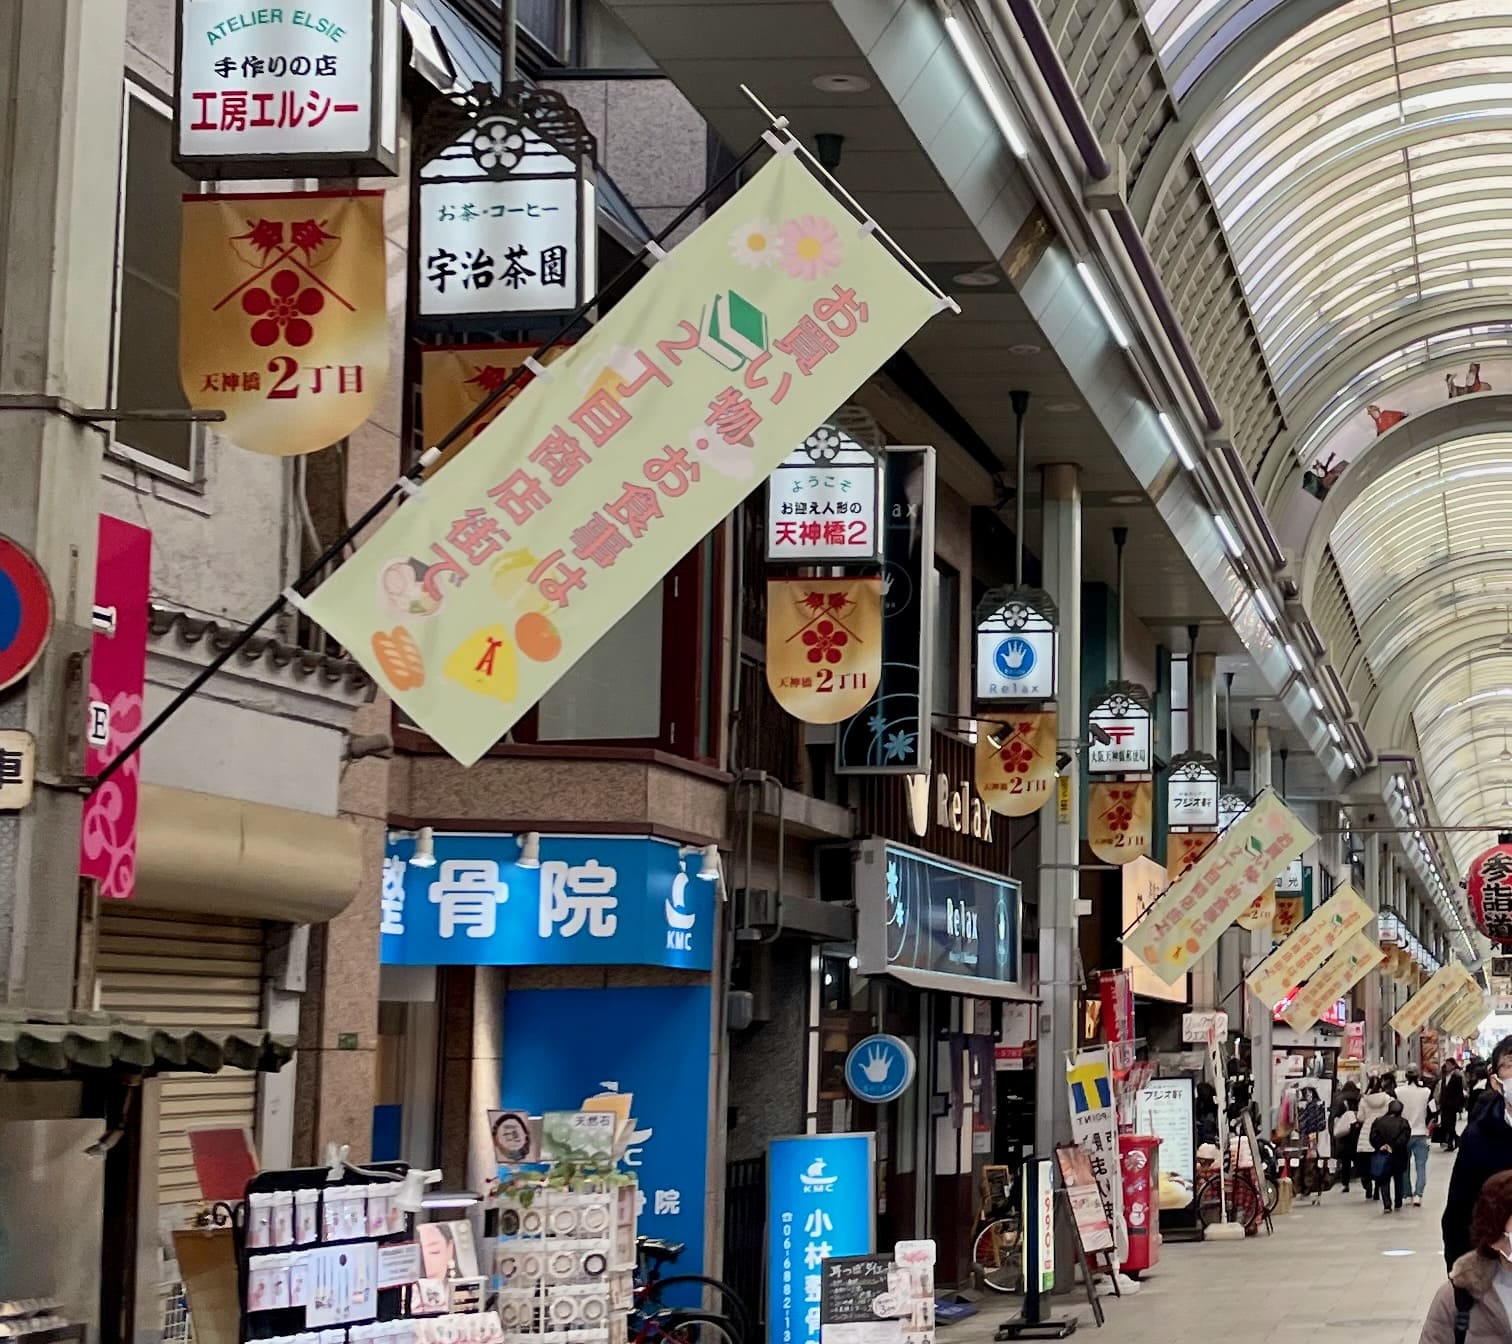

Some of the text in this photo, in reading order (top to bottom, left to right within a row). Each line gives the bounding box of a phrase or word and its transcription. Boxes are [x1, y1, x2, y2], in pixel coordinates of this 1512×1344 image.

[206, 8, 347, 46] ATELIER ELSIE
[214, 54, 337, 78] 手作りの店
[190, 90, 359, 132] 工房エルシー
[437, 202, 559, 223] お茶・コーヒー
[426, 246, 568, 293] 宇治茶園
[528, 283, 870, 608] お買い物・お食事は
[423, 319, 701, 603] 2丁目商店街で
[792, 475, 852, 493] ようこそ
[781, 502, 862, 515] お迎え人形の
[775, 520, 868, 546] 天神橋2
[989, 682, 1040, 694] Relax
[936, 773, 994, 843] Relax
[946, 896, 979, 942] Relax
[667, 930, 692, 951] KMC
[803, 1185, 834, 1193] KMC
